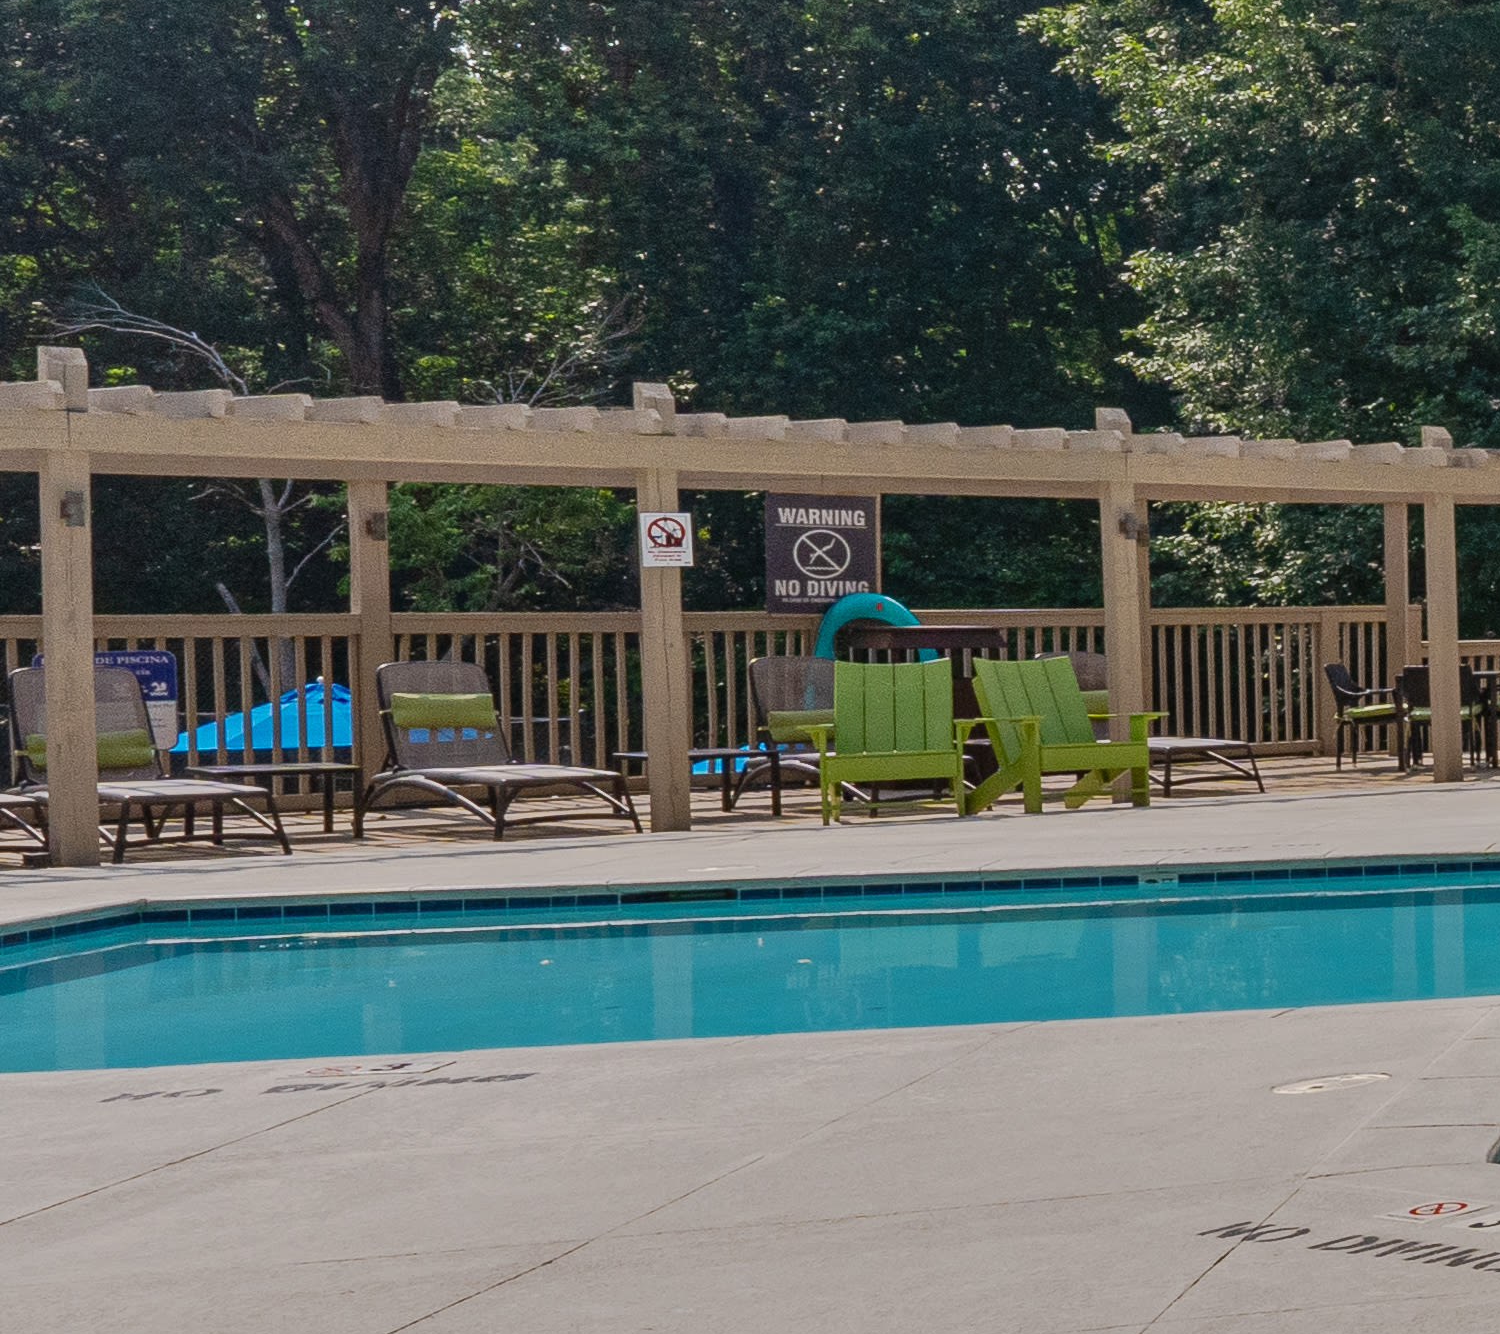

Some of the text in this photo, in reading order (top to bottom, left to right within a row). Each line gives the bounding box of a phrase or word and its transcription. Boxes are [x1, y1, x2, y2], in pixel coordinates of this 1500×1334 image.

[778, 507, 866, 526] WARNING
[774, 579, 870, 597] NO DIVING
[116, 655, 169, 665] PISCINA
[99, 1088, 224, 1103] NO
[1196, 1221, 1312, 1243] NO
